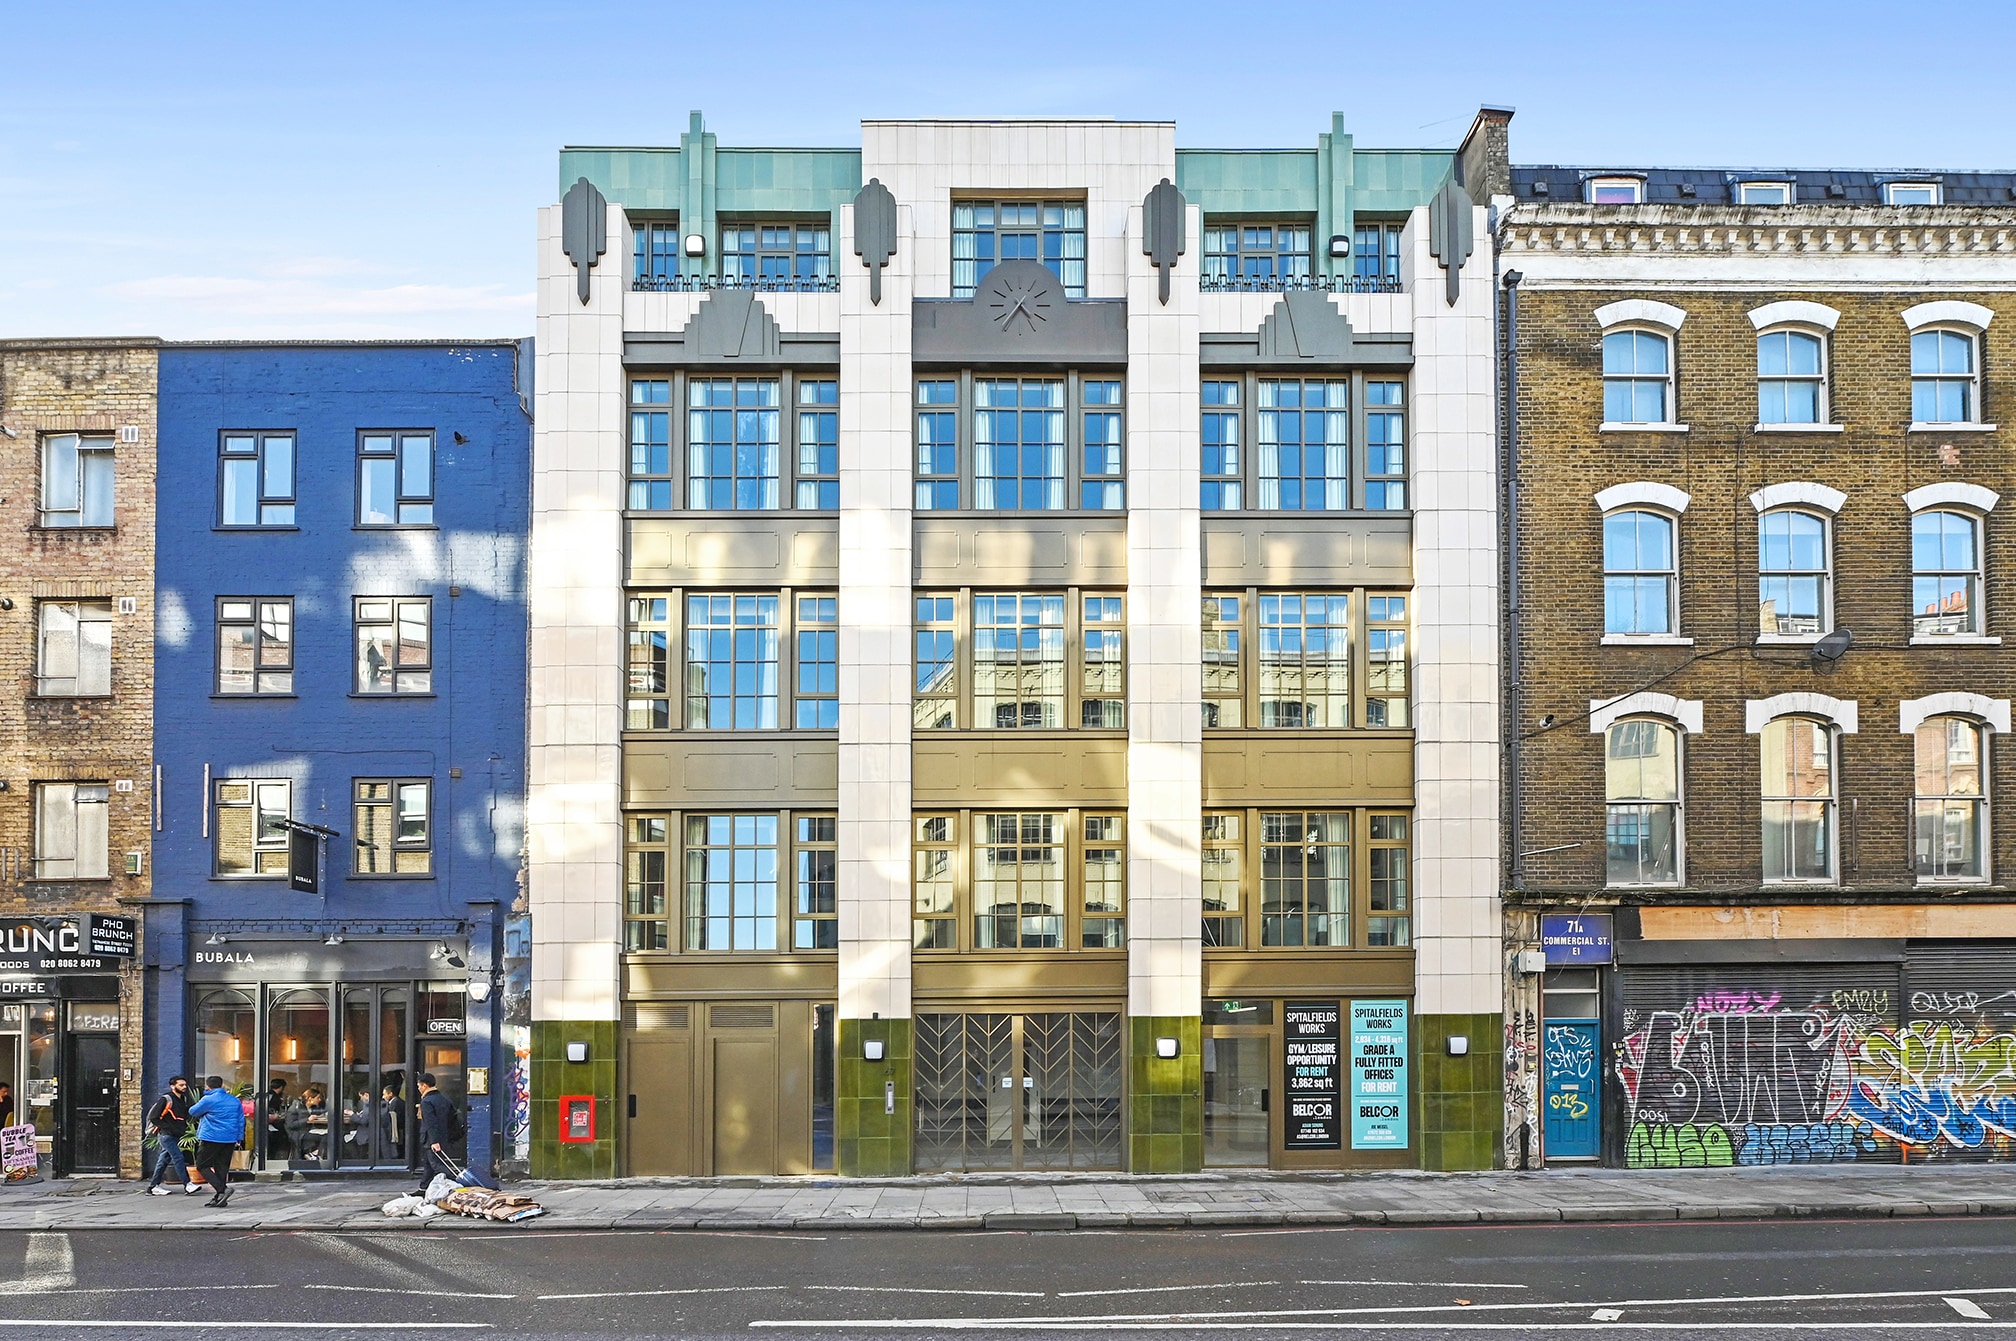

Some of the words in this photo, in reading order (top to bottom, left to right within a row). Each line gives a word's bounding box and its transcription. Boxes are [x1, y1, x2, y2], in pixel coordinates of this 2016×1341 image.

[102, 919, 123, 930] PHO
[92, 927, 133, 940] BRUNCH
[0, 928, 79, 953] UNC
[1543, 936, 1594, 945] COMMERCIAL
[1597, 936, 1610, 945] ST.
[1572, 947, 1580, 956] E1
[195, 952, 255, 963] BUBALA
[40, 959, 56, 968] 020
[57, 959, 78, 968] 8062
[80, 959, 101, 968] 8479
[0, 982, 46, 993] OFFEE
[1287, 1012, 1337, 1022] SPITALFIELDS
[1355, 1008, 1403, 1018] SPITALFIELDS
[429, 1021, 461, 1032] OPEN
[1298, 1023, 1325, 1034] WORKS
[1366, 1019, 1392, 1029] WORKS
[1288, 1043, 1336, 1054] GYM/LEISURE
[1363, 1045, 1388, 1055] GRADE
[1389, 1045, 1395, 1055] A
[1287, 1054, 1337, 1065] OPPORTUNITY
[1355, 1057, 1377, 1068] FULLY
[1378, 1057, 1403, 1067] FITTED
[1296, 1066, 1309, 1077] FOR
[1310, 1066, 1329, 1077] RENT
[1364, 1069, 1394, 1080] OFFICES
[1291, 1078, 1313, 1088] 3,862
[1314, 1079, 1324, 1090] sq
[1325, 1078, 1333, 1088] ft
[1361, 1082, 1377, 1093] FOR
[1378, 1081, 1397, 1092] RENT
[1293, 1104, 1332, 1116] BELCOR
[1360, 1105, 1399, 1118] BELCOR
[2, 1128, 26, 1136] BUBBLE
[15, 1148, 34, 1156] COFFEE
